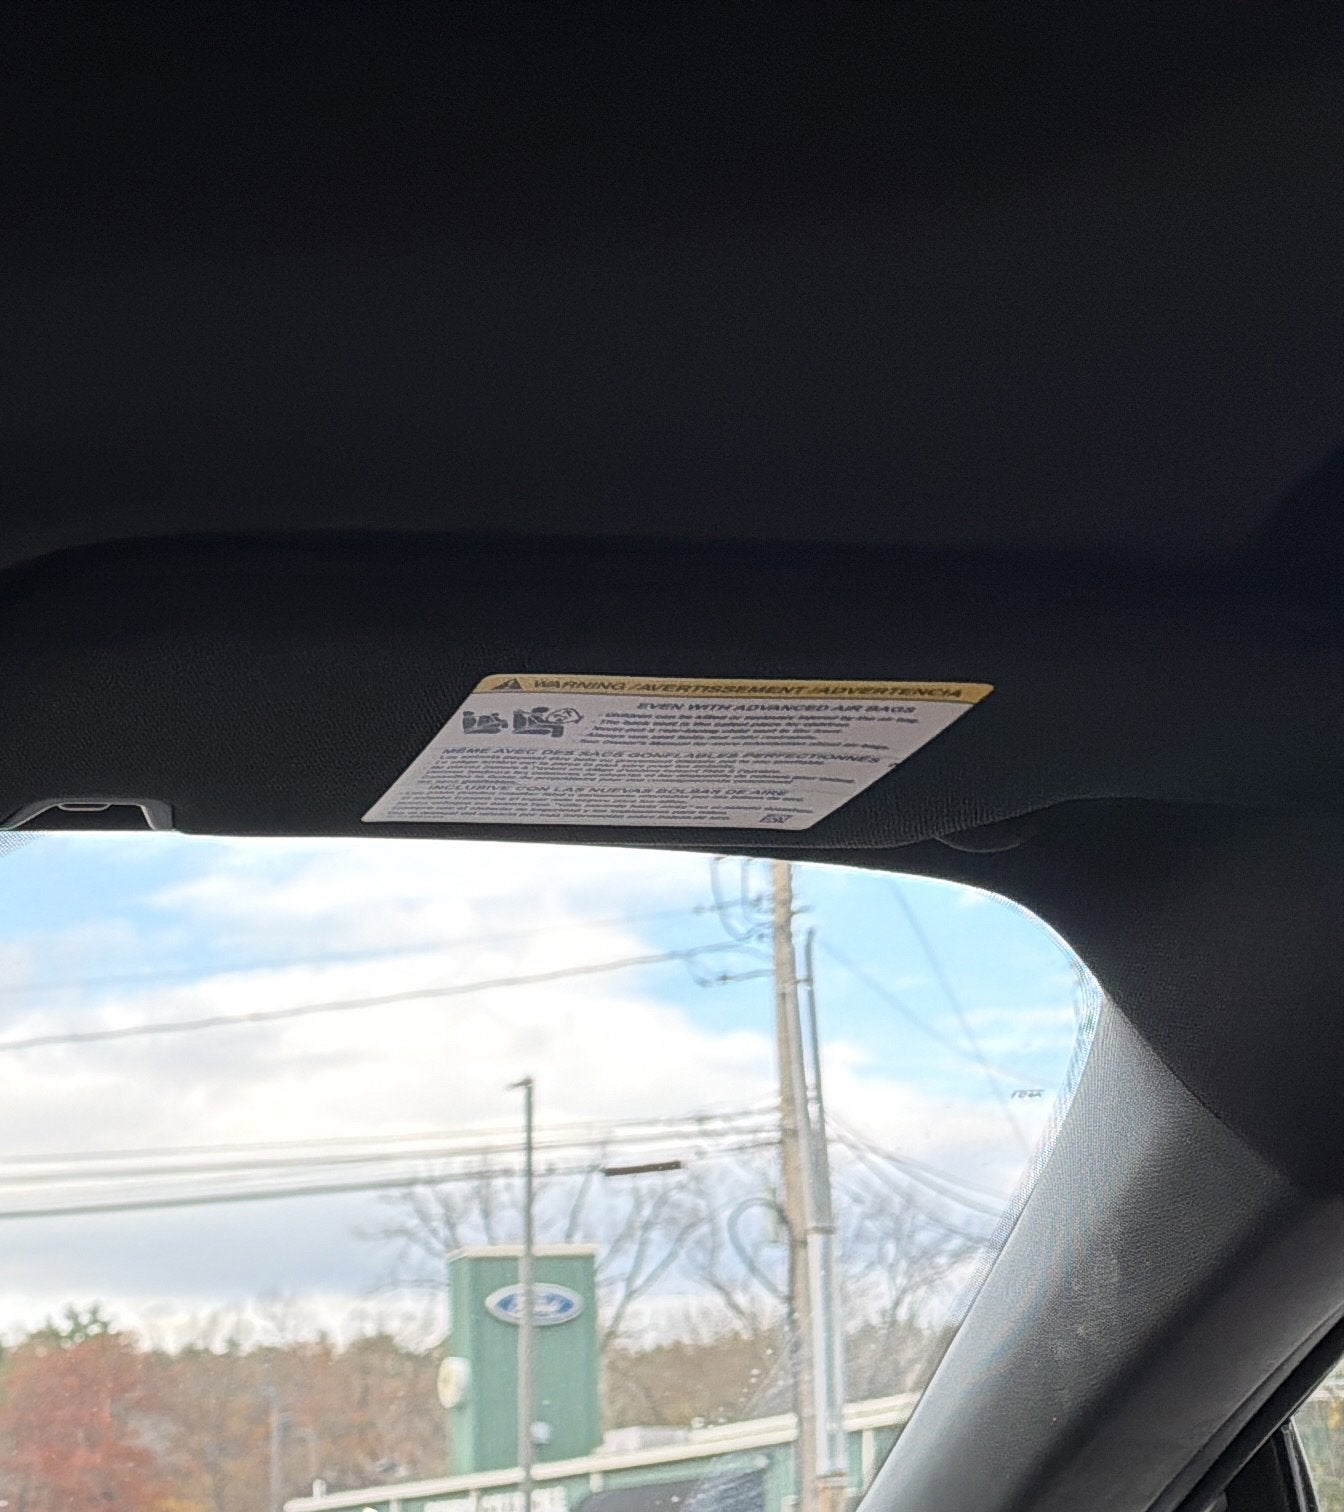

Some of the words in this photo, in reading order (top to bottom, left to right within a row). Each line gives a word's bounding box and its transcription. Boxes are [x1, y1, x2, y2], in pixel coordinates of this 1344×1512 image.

[533, 679, 627, 691] WARNING
[637, 702, 684, 711] EVEN
[686, 703, 732, 712] WITH
[733, 704, 831, 713] ADVANCED
[831, 704, 864, 713] AIR
[865, 705, 916, 714] BAGS
